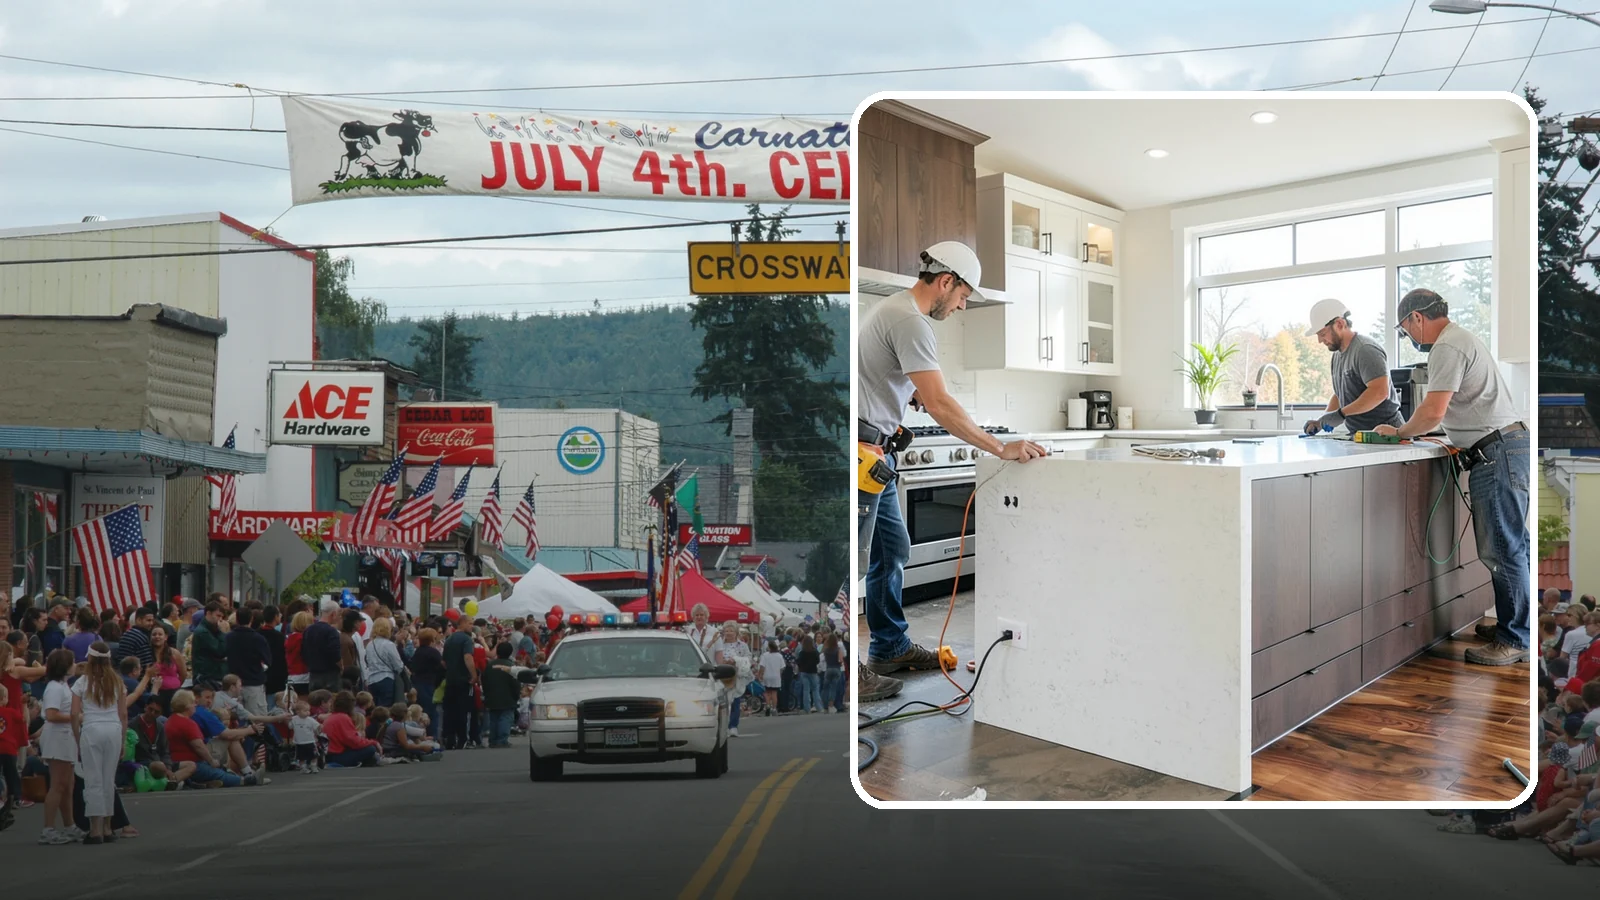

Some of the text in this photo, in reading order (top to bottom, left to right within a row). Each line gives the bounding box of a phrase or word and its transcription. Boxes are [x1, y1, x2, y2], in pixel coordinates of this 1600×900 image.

[481, 140, 604, 192] JULY
[632, 149, 746, 198] 4th.
[697, 254, 850, 280] CROSSWA
[283, 380, 373, 420] ACE
[406, 409, 452, 422] CEDAR
[284, 421, 370, 436] Hardware
[416, 428, 476, 447] Coca-Cola
[353, 467, 387, 479] Simpl
[95, 485, 124, 494] Vincent
[126, 485, 135, 494] de
[137, 486, 155, 495] Paul
[688, 526, 741, 535] CRNATION
[699, 535, 730, 543] GLASS
